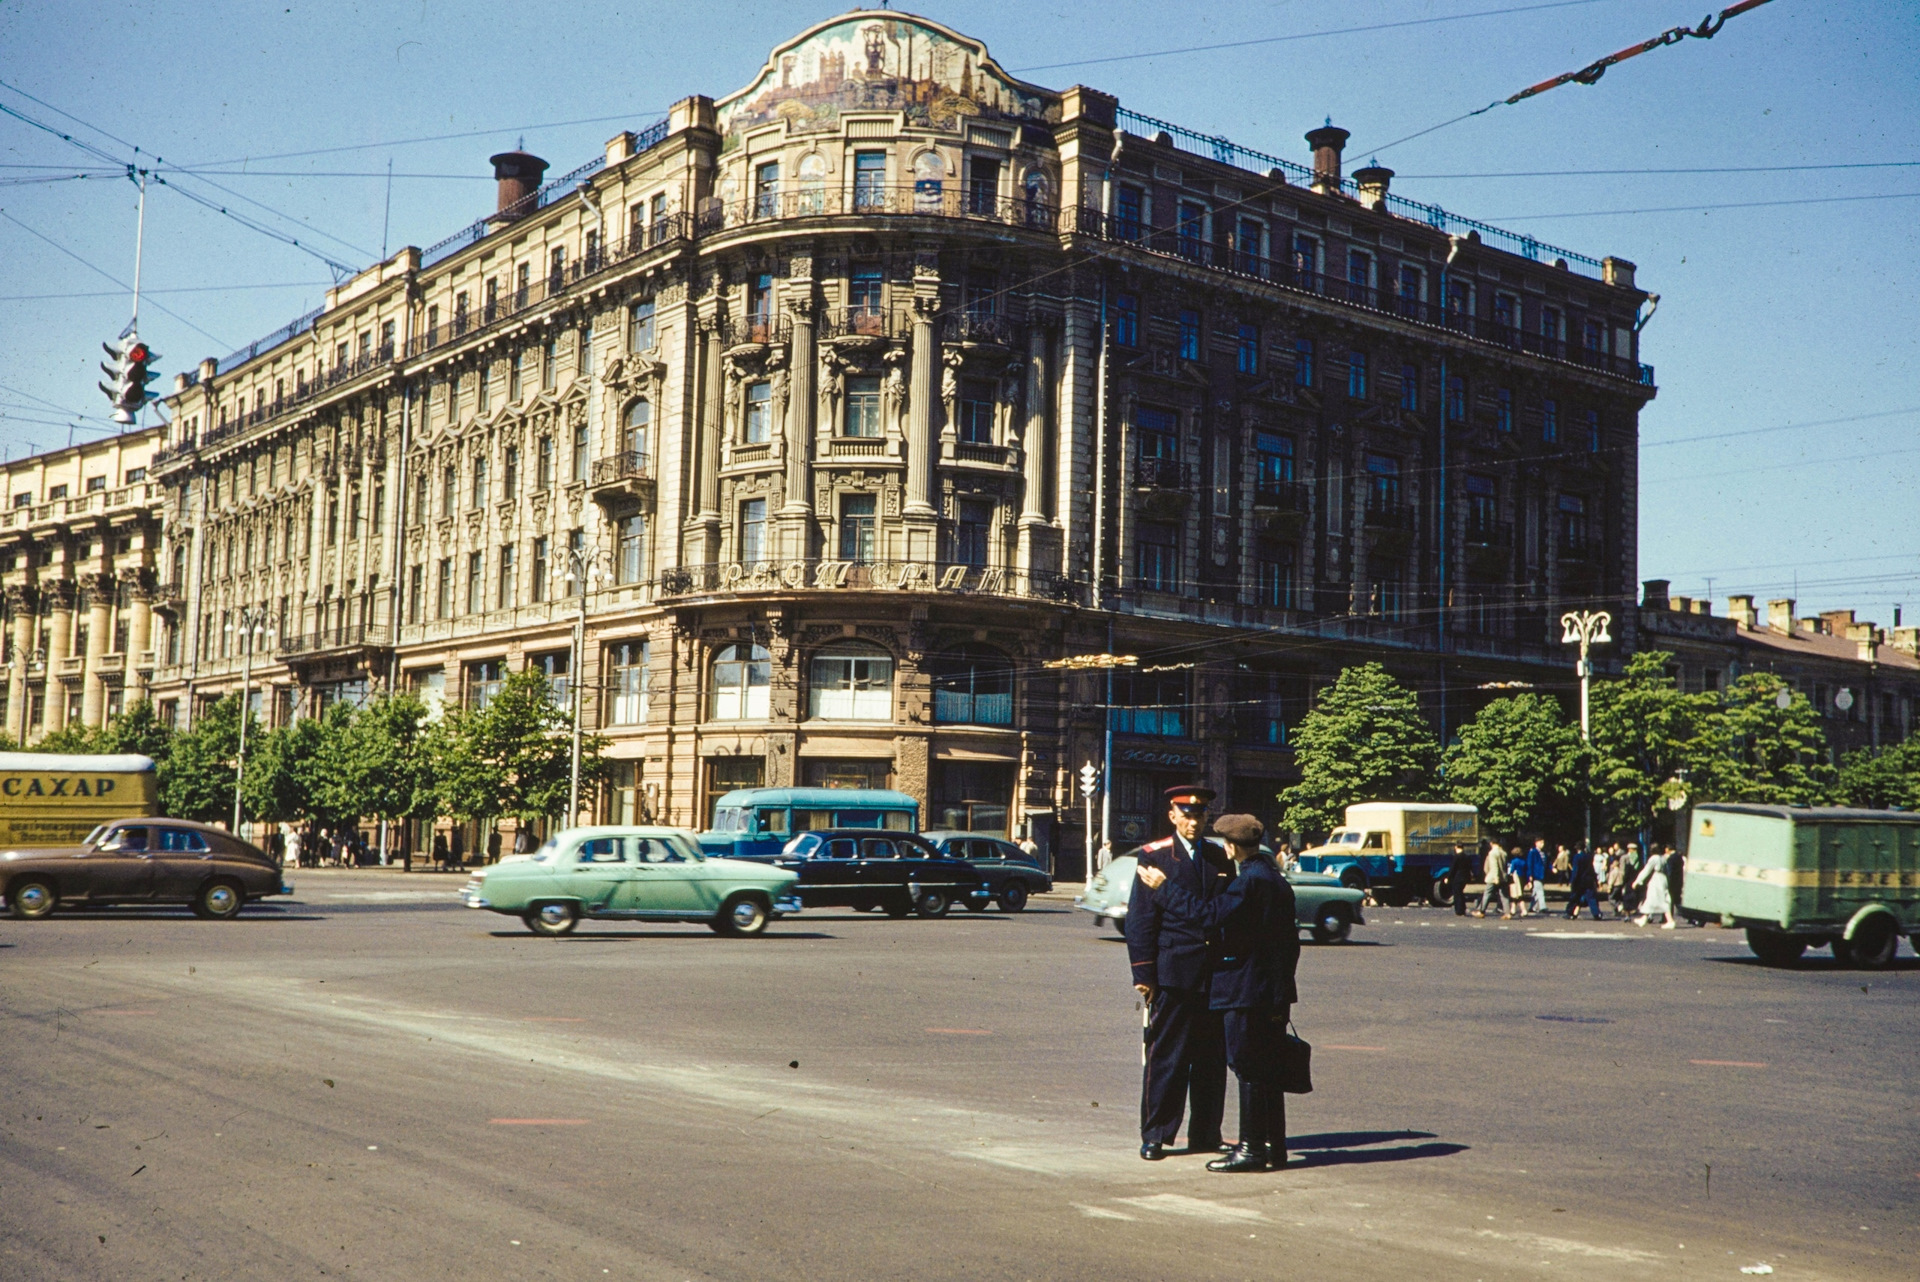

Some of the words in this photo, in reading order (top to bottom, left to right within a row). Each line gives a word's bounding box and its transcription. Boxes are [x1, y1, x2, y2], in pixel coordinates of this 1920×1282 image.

[721, 561, 1004, 592] РЕСТОРАН
[1122, 749, 1198, 766] Кафе
[2, 777, 115, 797] САХАР
